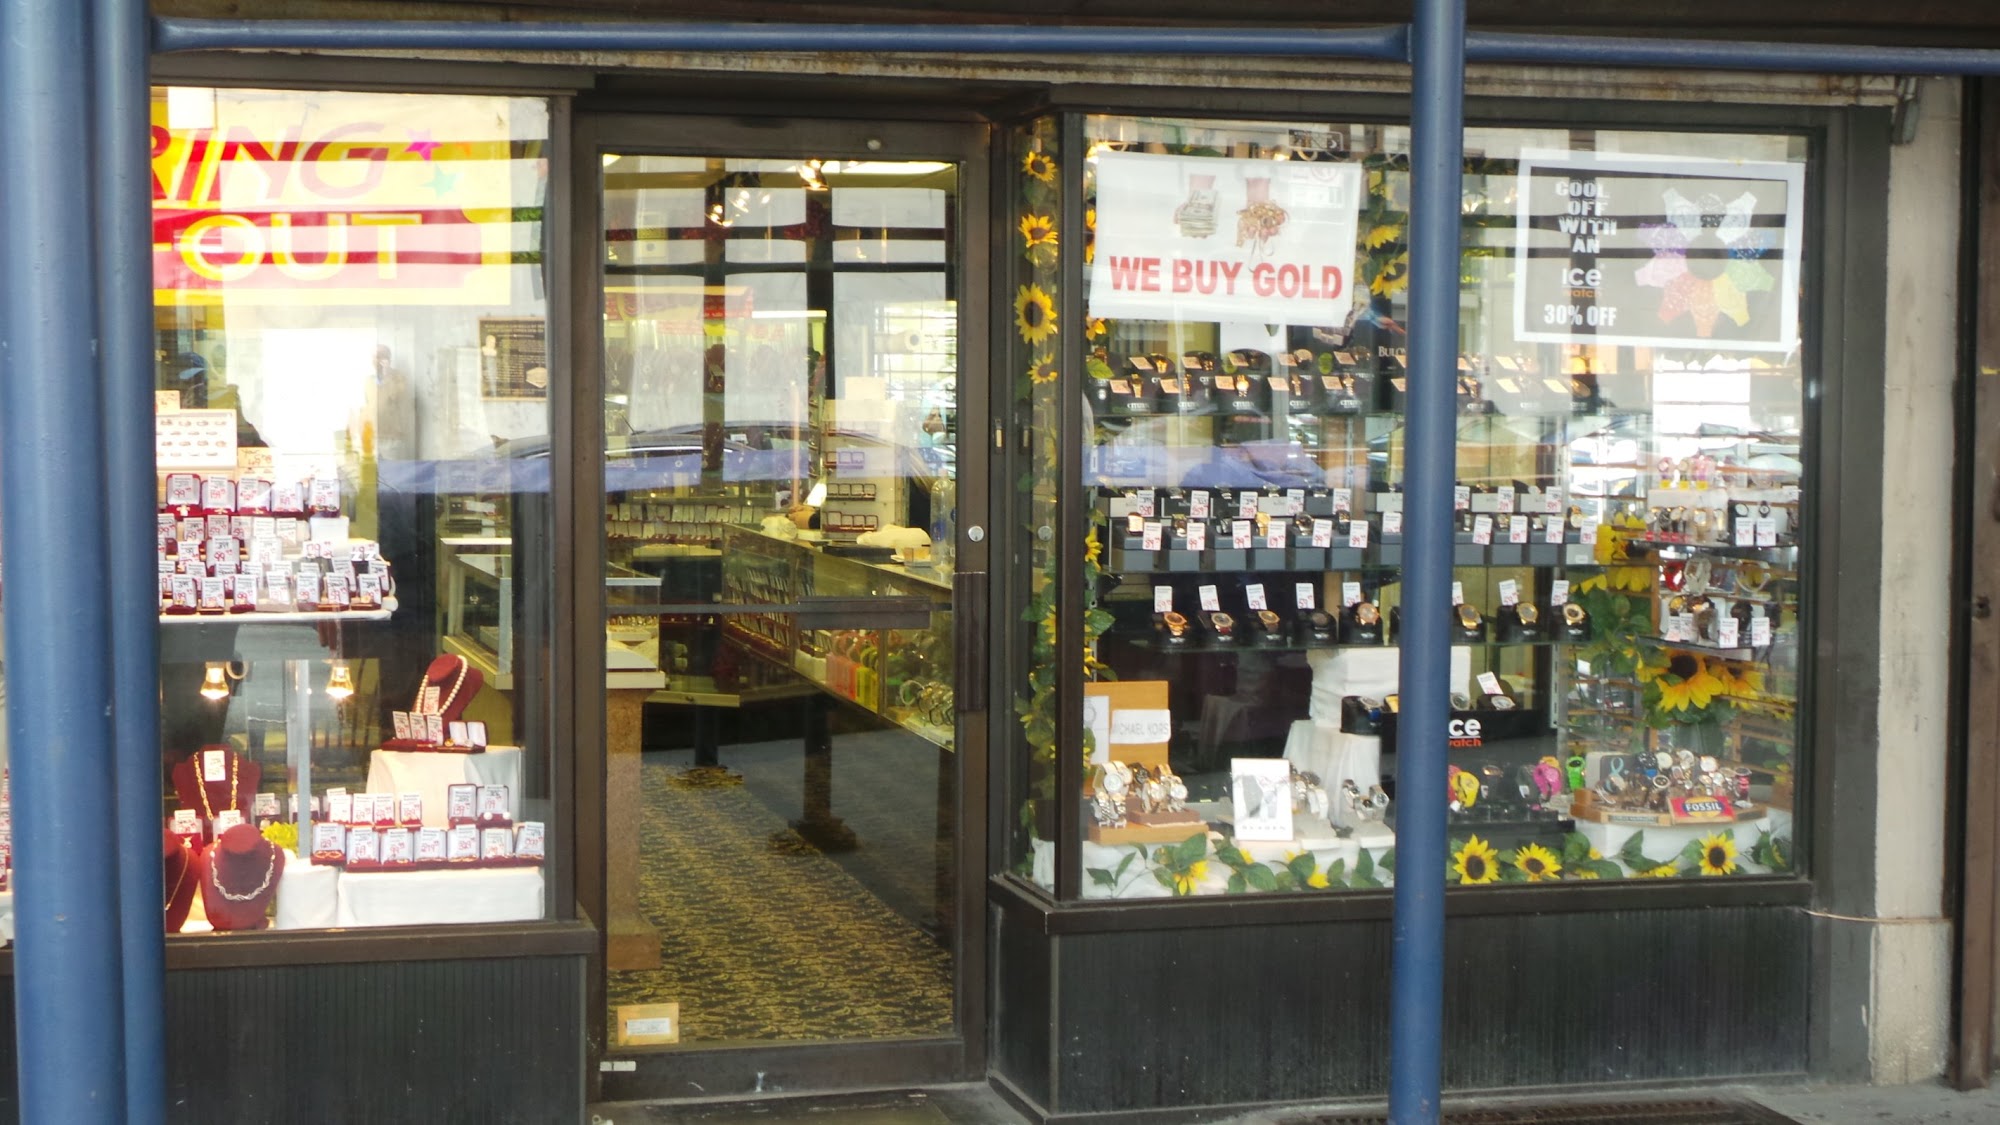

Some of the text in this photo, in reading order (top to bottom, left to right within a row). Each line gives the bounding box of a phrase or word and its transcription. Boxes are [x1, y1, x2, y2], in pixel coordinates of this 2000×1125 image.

[1555, 180, 1610, 198] COOL
[1567, 199, 1609, 216] OFF
[1558, 216, 1618, 236] WITH
[179, 212, 423, 282] OUT
[1571, 236, 1601, 254] AN
[1109, 255, 1343, 299] WE BUY GOLD
[1543, 304, 1618, 327] 30% OFF
[1448, 718, 1482, 737] ce
[1685, 802, 1723, 812] FOSSIL
